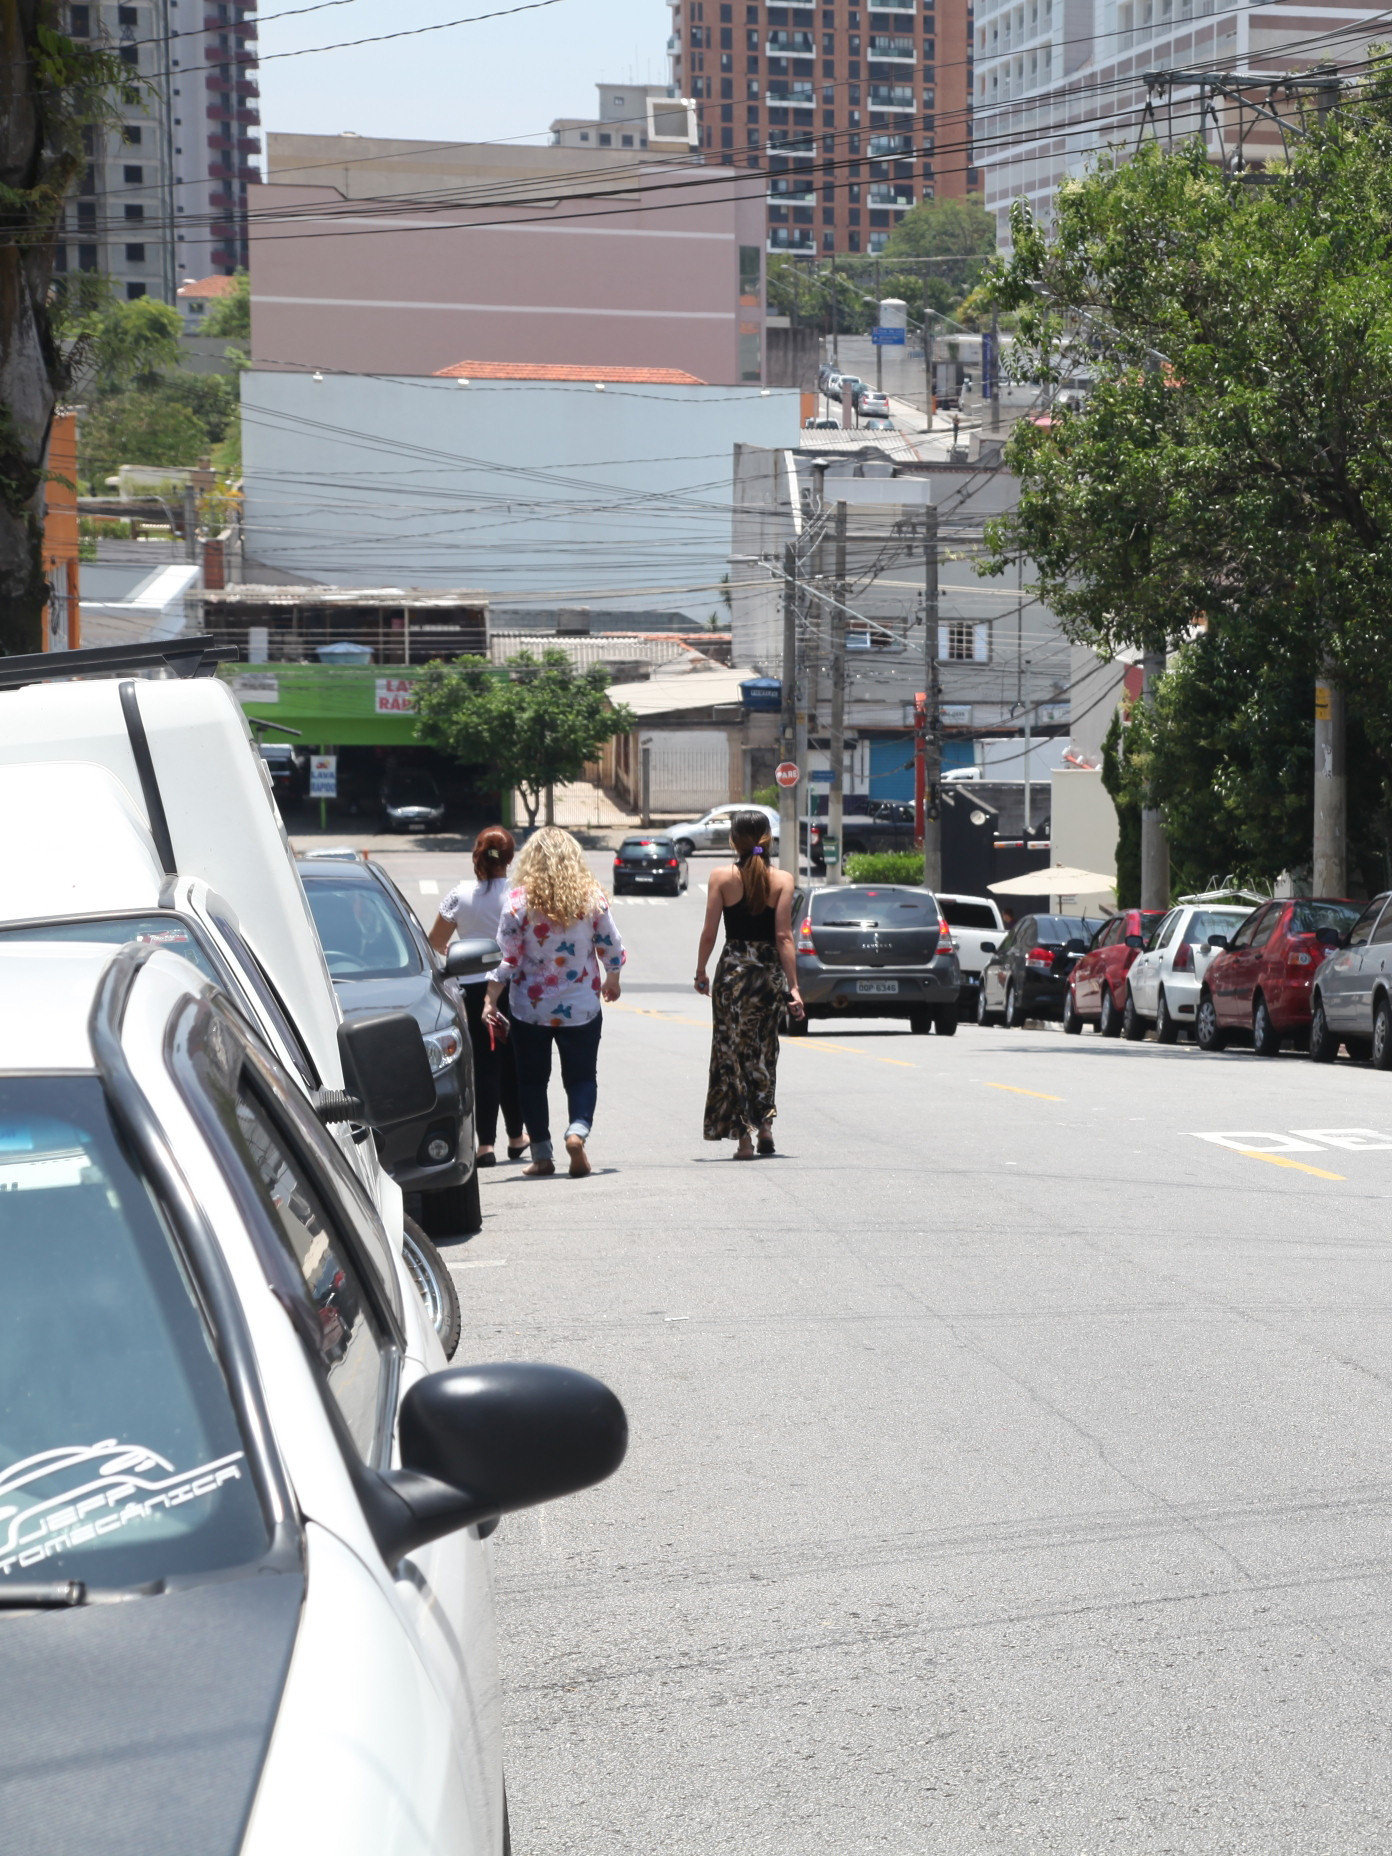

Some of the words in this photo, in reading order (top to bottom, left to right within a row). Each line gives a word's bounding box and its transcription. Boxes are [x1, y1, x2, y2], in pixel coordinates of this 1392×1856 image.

[311, 771, 335, 779] LAVA
[776, 769, 797, 779] PARE
[19, 1483, 137, 1545] JEFF
